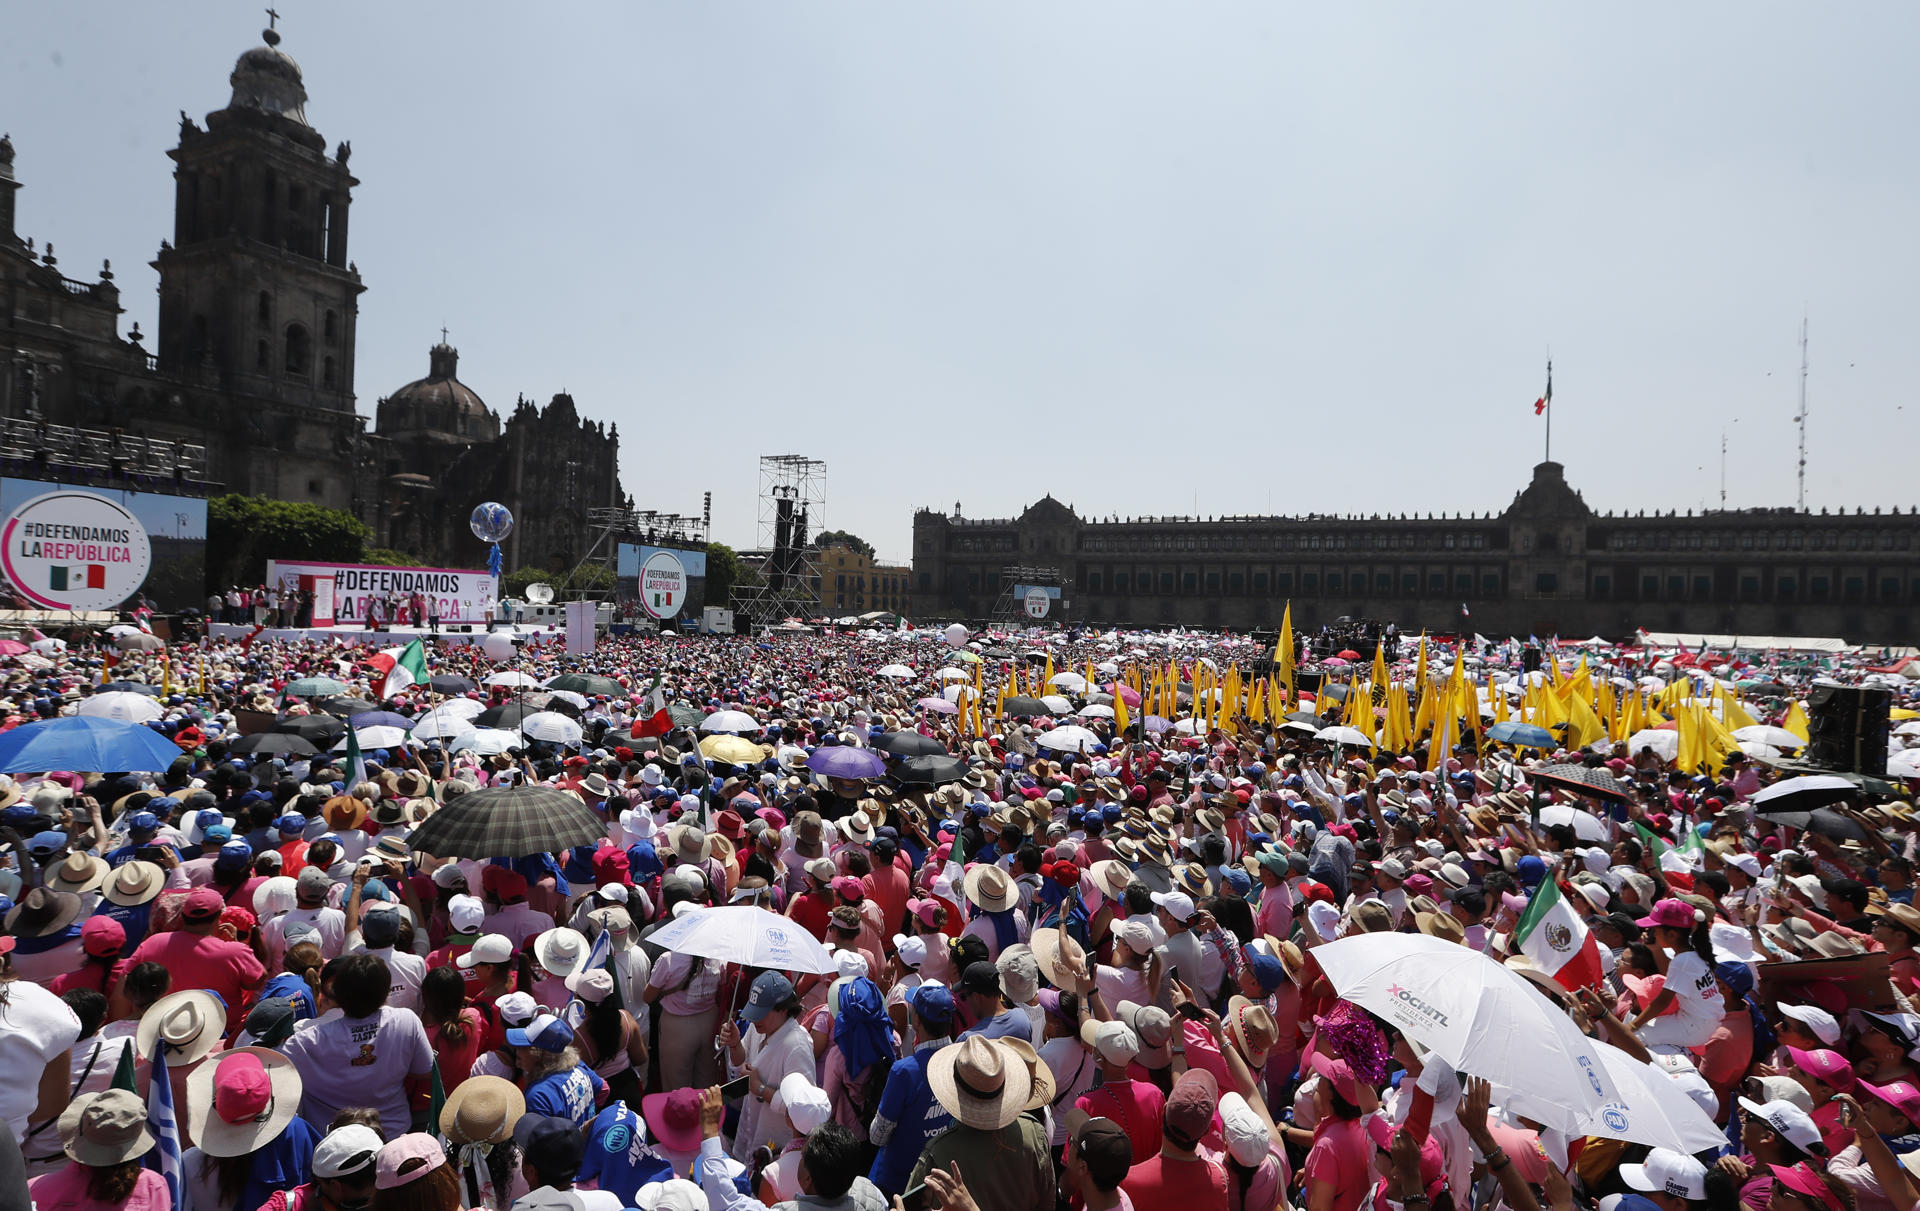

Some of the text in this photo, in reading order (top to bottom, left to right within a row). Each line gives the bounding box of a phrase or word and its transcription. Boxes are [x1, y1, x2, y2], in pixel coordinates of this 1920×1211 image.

[24, 522, 130, 544] #DEFENDAMOS
[21, 540, 131, 563] LAREPÚBLICA
[335, 570, 460, 593] #DEFENDAMOS
[647, 569, 680, 580] #DEFENDAMOS
[646, 580, 681, 591] LAREPÚBLICA
[1385, 983, 1448, 1027] XÓCHITL
[1389, 997, 1434, 1028] PRESIDENTA
[1607, 1115, 1625, 1127] PAN
[611, 1129, 625, 1147] PAN
[923, 1126, 948, 1138] VOTA
